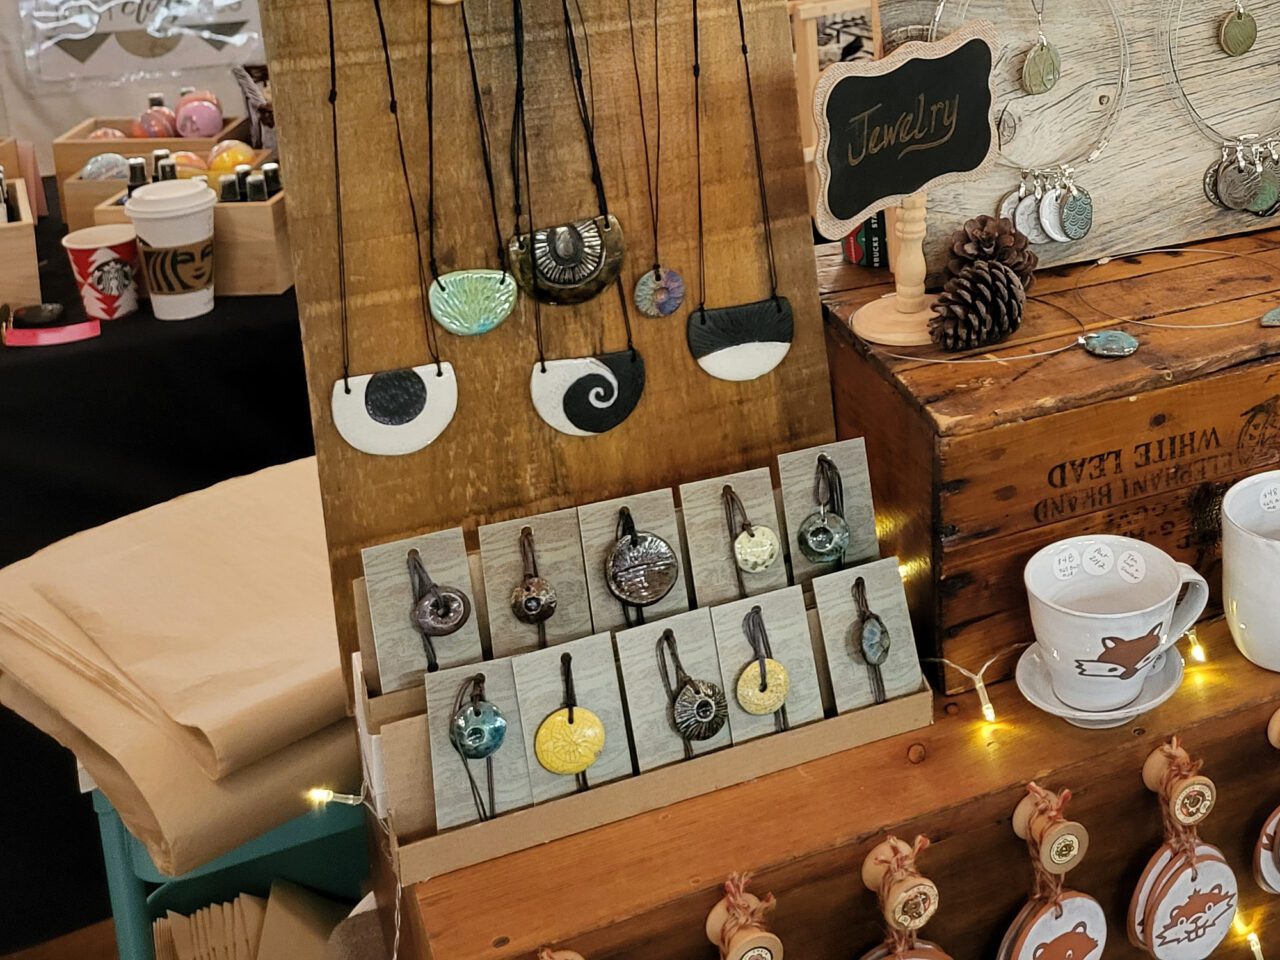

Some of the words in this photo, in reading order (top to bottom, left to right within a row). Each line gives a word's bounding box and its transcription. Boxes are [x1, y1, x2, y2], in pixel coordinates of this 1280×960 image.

[847, 92, 960, 166] Jewelry
[1047, 448, 1123, 489] LEAD
[1134, 426, 1221, 469] WHITE
